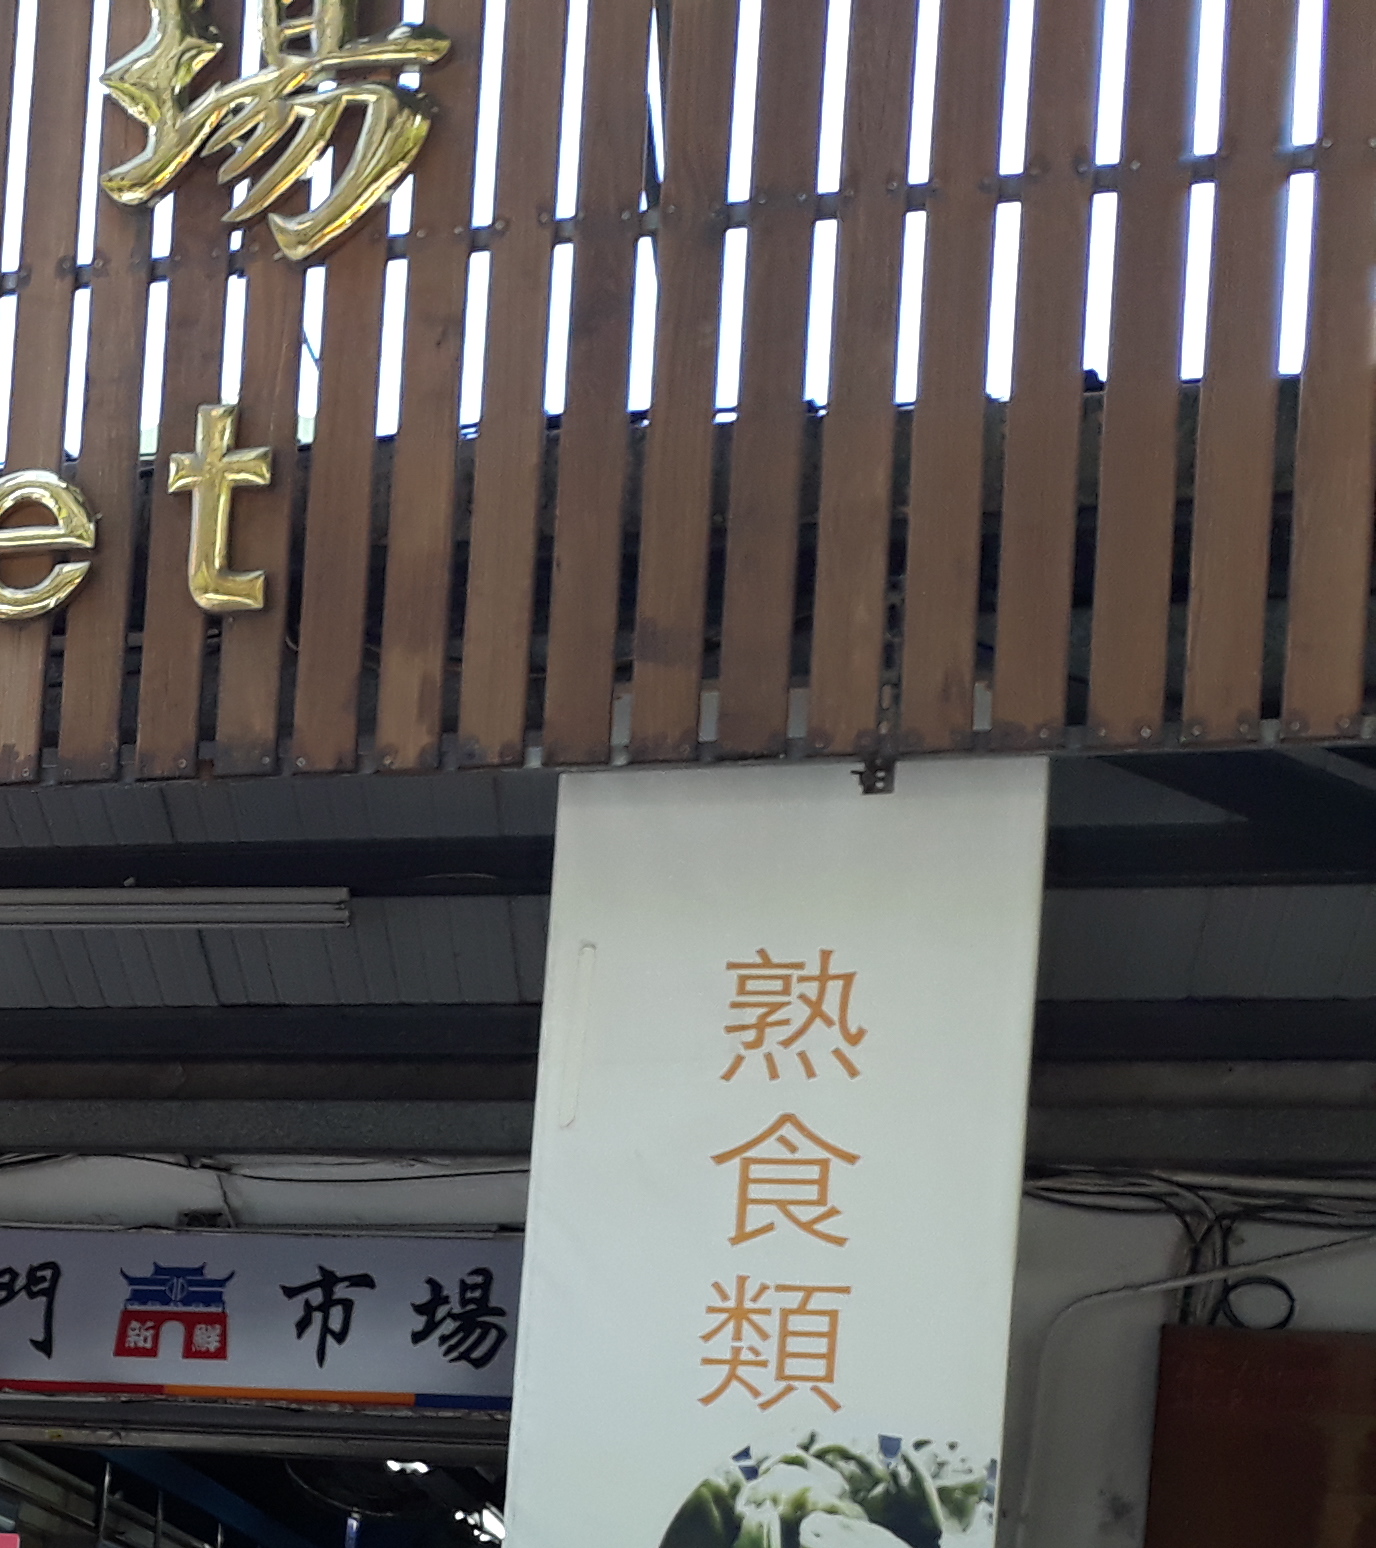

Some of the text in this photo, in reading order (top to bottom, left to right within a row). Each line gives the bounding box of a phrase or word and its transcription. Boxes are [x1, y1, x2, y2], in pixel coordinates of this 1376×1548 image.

[279, 1261, 509, 1369] 市場
[695, 947, 868, 1413] 熟食類
